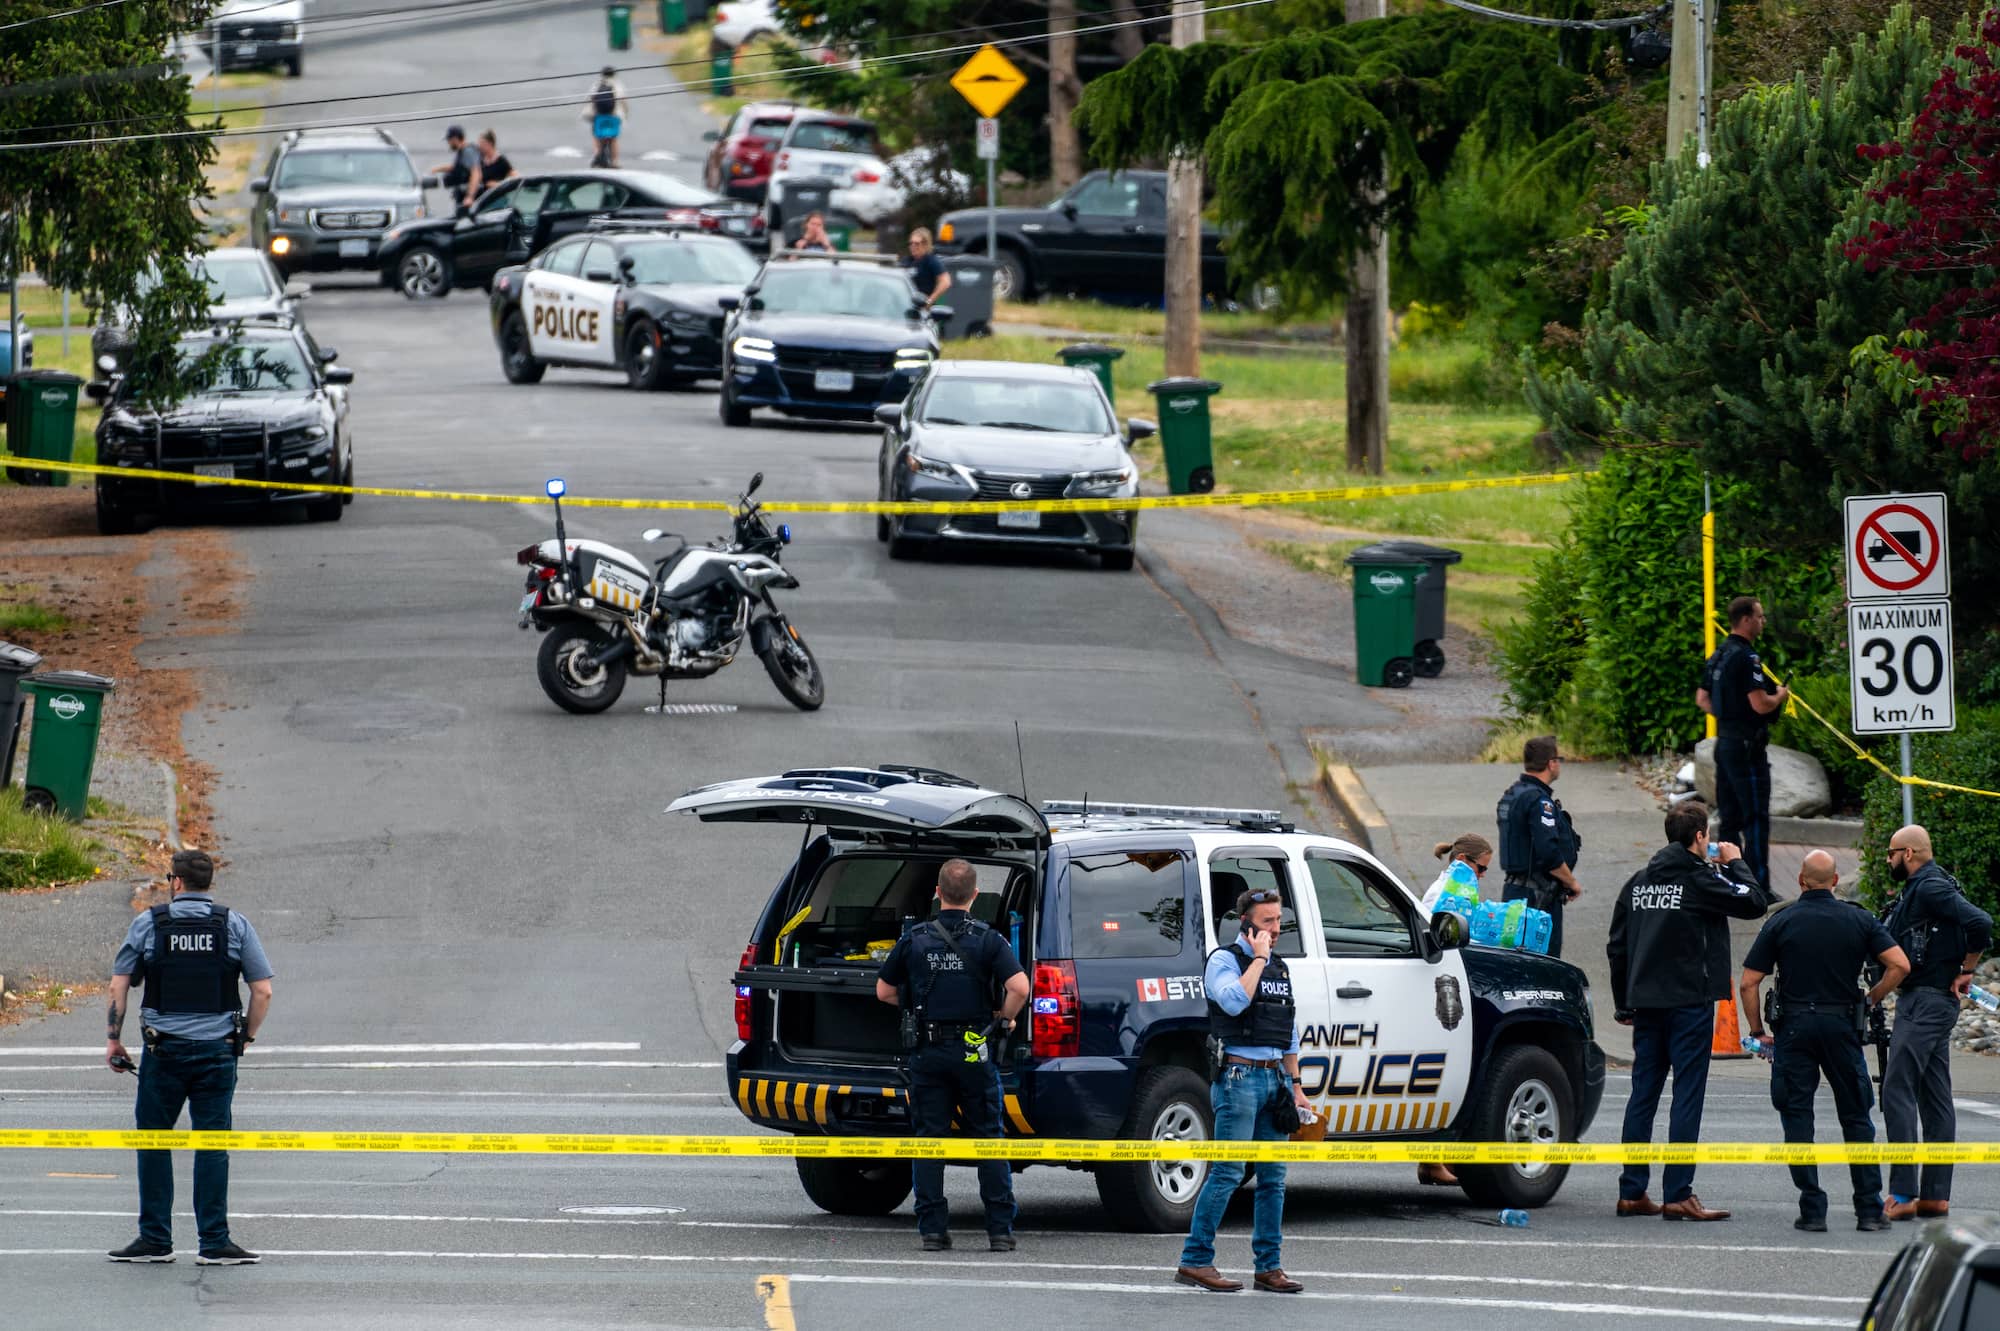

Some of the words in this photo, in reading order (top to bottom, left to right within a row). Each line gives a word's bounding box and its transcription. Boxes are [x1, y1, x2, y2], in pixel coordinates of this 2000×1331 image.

[534, 305, 599, 342] POLICE
[1858, 608, 1942, 631] MAXIMUM
[1860, 635, 1944, 697] 30
[1873, 703, 1935, 723] km/h
[811, 790, 890, 807] POLICE
[1632, 884, 1683, 896] SAANICH
[1632, 894, 1682, 911] POLICE
[170, 934, 213, 952] POLICE
[930, 961, 964, 971] POLICE
[1167, 981, 1206, 1000] 9-1-1
[1261, 981, 1289, 996] POLICE
[1502, 989, 1566, 1001] SUPERVISOR
[1299, 1022, 1379, 1048] ANICH
[1299, 1052, 1448, 1098] OLICE
